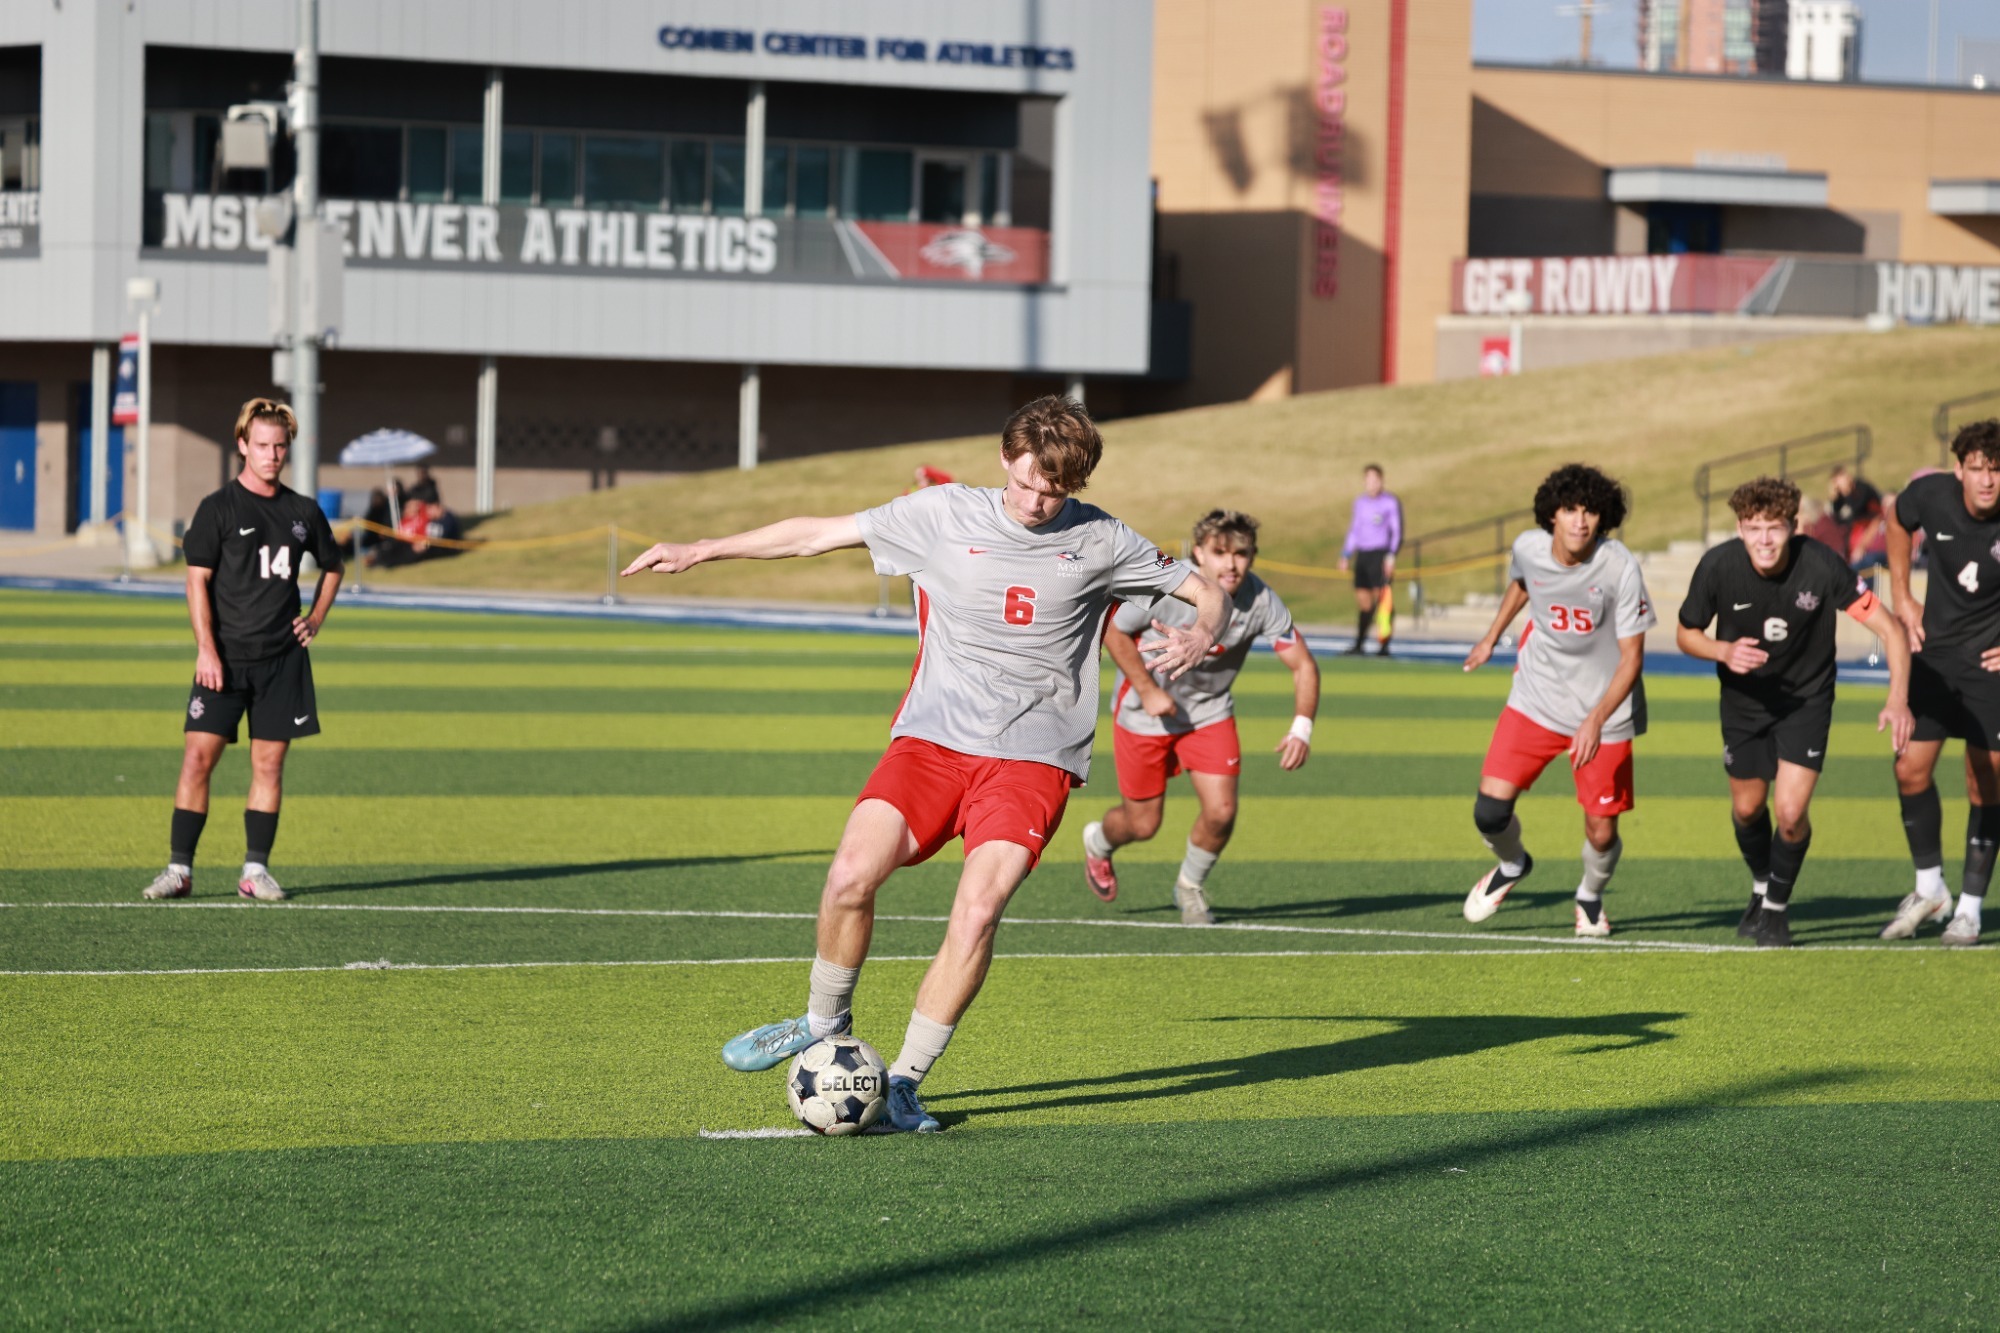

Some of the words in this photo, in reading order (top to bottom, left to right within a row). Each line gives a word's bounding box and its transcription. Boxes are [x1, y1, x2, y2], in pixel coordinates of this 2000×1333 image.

[763, 32, 867, 59] CENTER
[877, 37, 926, 63] FOR
[935, 41, 1074, 71] ATHLETICS
[1315, 6, 1349, 298] ROADRUNNERS
[318, 199, 503, 263] ENVER
[520, 207, 778, 275] ATHLETICS
[1463, 257, 1534, 314] GET
[1541, 254, 1679, 314] ROWDY
[1876, 261, 2000, 323] HOME
[258, 544, 292, 580] 14
[1057, 562, 1084, 573] MSU
[1957, 560, 1979, 593] 4
[1002, 584, 1038, 628] 6
[1550, 604, 1594, 635] 35
[1764, 616, 1788, 642] 6
[821, 1075, 878, 1092] SELECT
